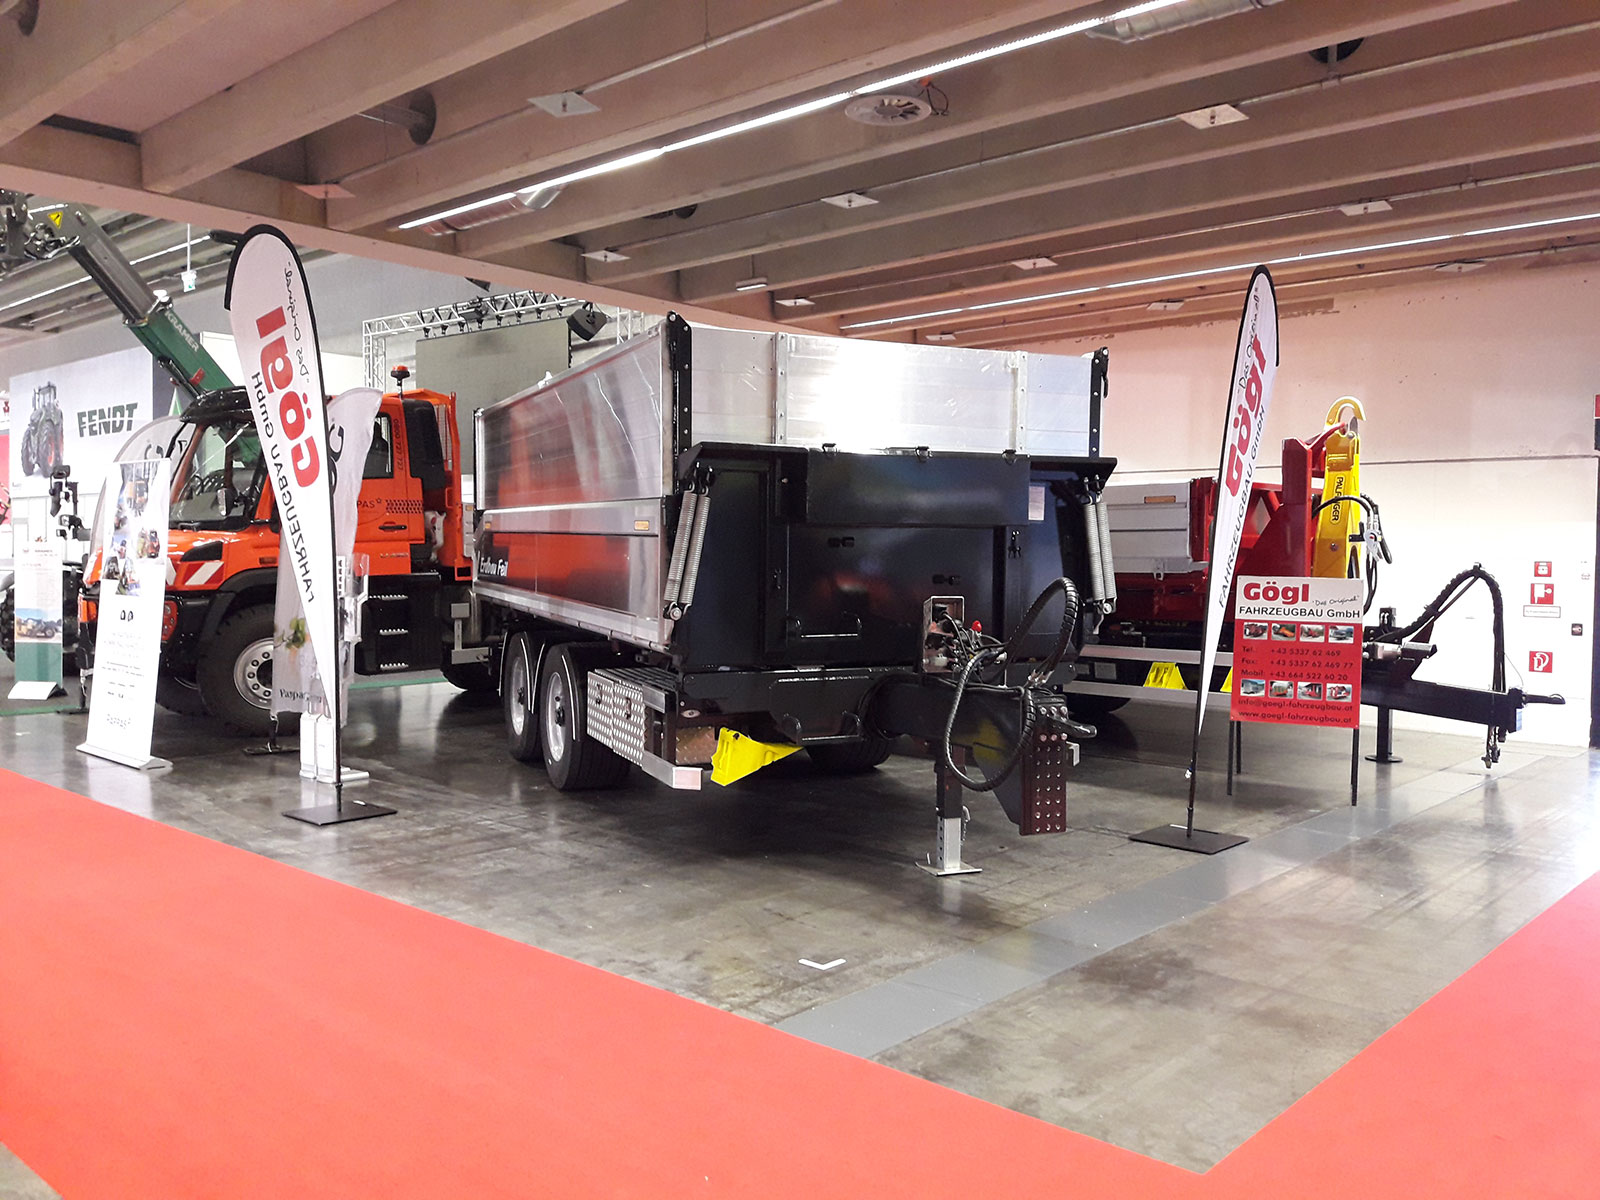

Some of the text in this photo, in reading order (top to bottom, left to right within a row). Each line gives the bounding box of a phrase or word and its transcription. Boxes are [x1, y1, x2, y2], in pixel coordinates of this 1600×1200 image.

[164, 310, 200, 352] KRAMER
[77, 402, 138, 438] FENDT
[1226, 333, 1266, 497] Gögl
[1332, 476, 1344, 521] PALFGER
[1218, 463, 1253, 608] FAHRZEUGBAU
[1239, 606, 1360, 618] FAHRZEUGBAU GmbH
[1243, 581, 1309, 605] Gögl
